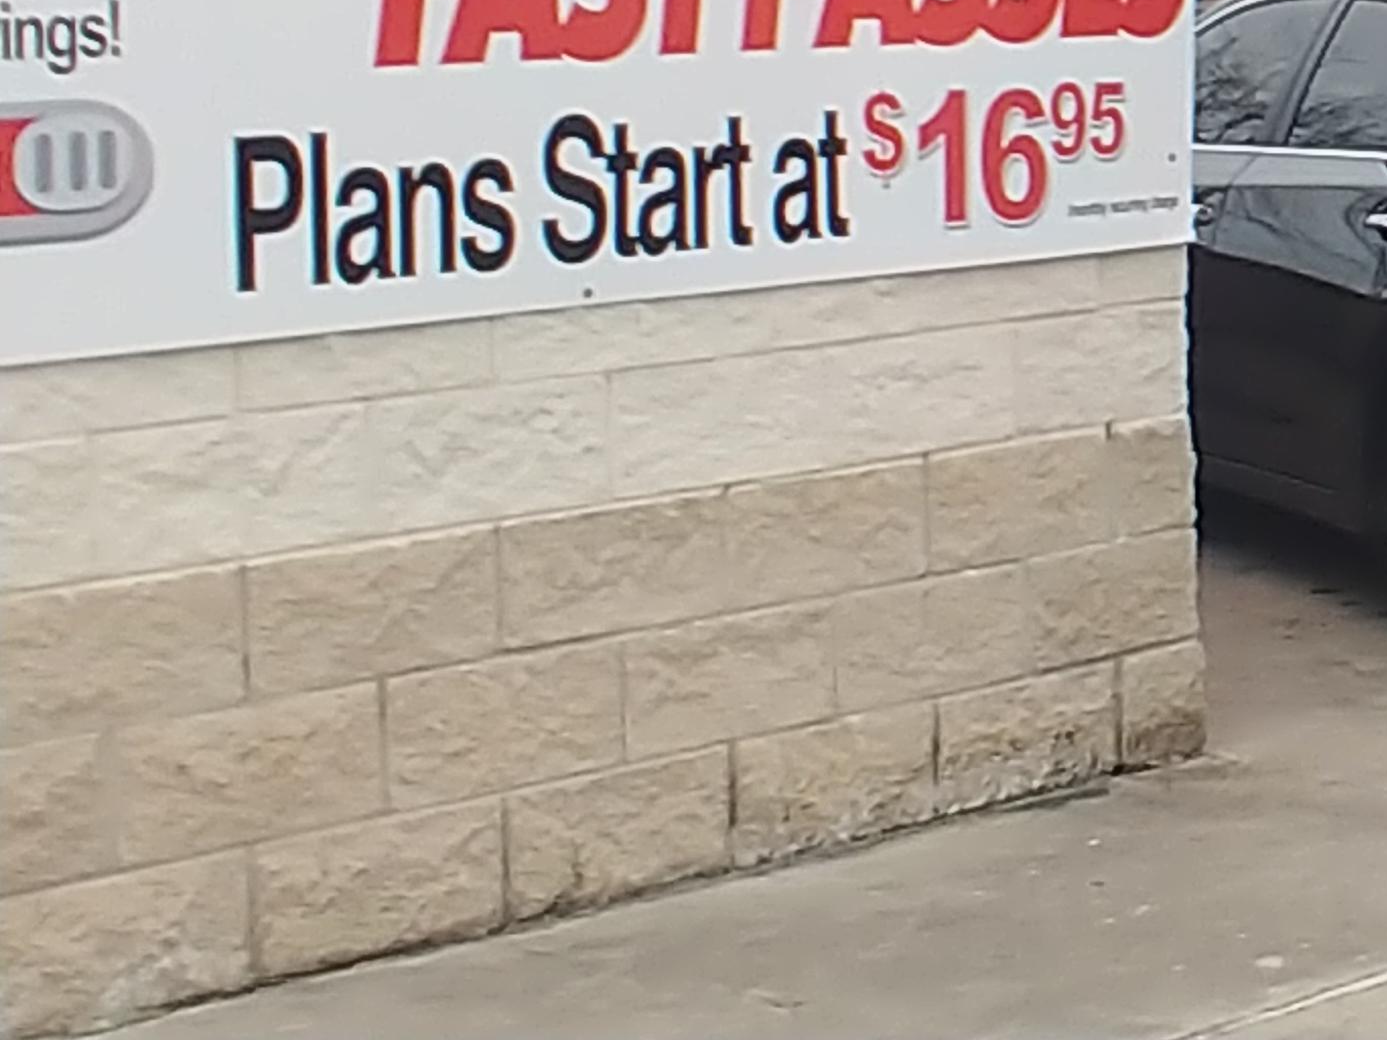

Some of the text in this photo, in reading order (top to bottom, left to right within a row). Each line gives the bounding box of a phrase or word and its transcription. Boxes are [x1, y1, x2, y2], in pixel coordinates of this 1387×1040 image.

[234, 132, 515, 291] Plans
[541, 114, 754, 263] Start
[773, 110, 852, 244] at
